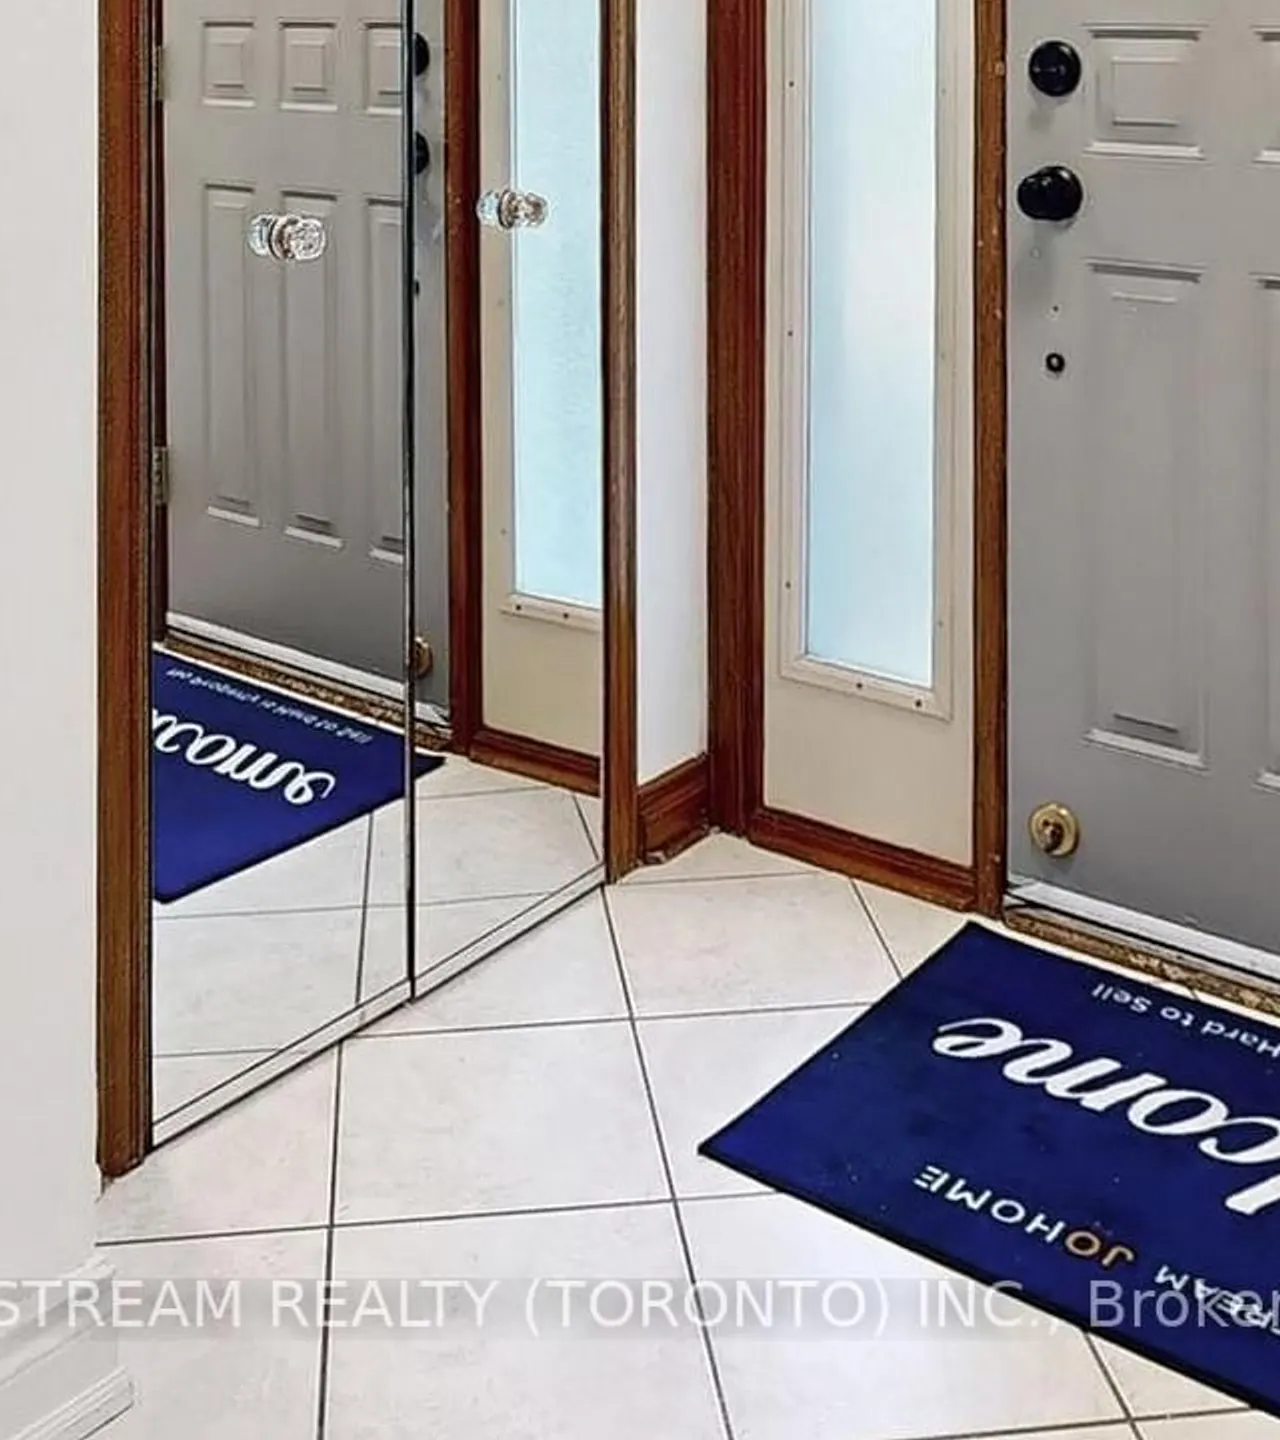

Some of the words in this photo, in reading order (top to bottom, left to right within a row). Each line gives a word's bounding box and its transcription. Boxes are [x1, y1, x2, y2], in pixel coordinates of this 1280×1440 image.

[1090, 982, 1153, 1013] Sell
[1159, 1005, 1195, 1027] to
[913, 1164, 1135, 1267] JOHOME
